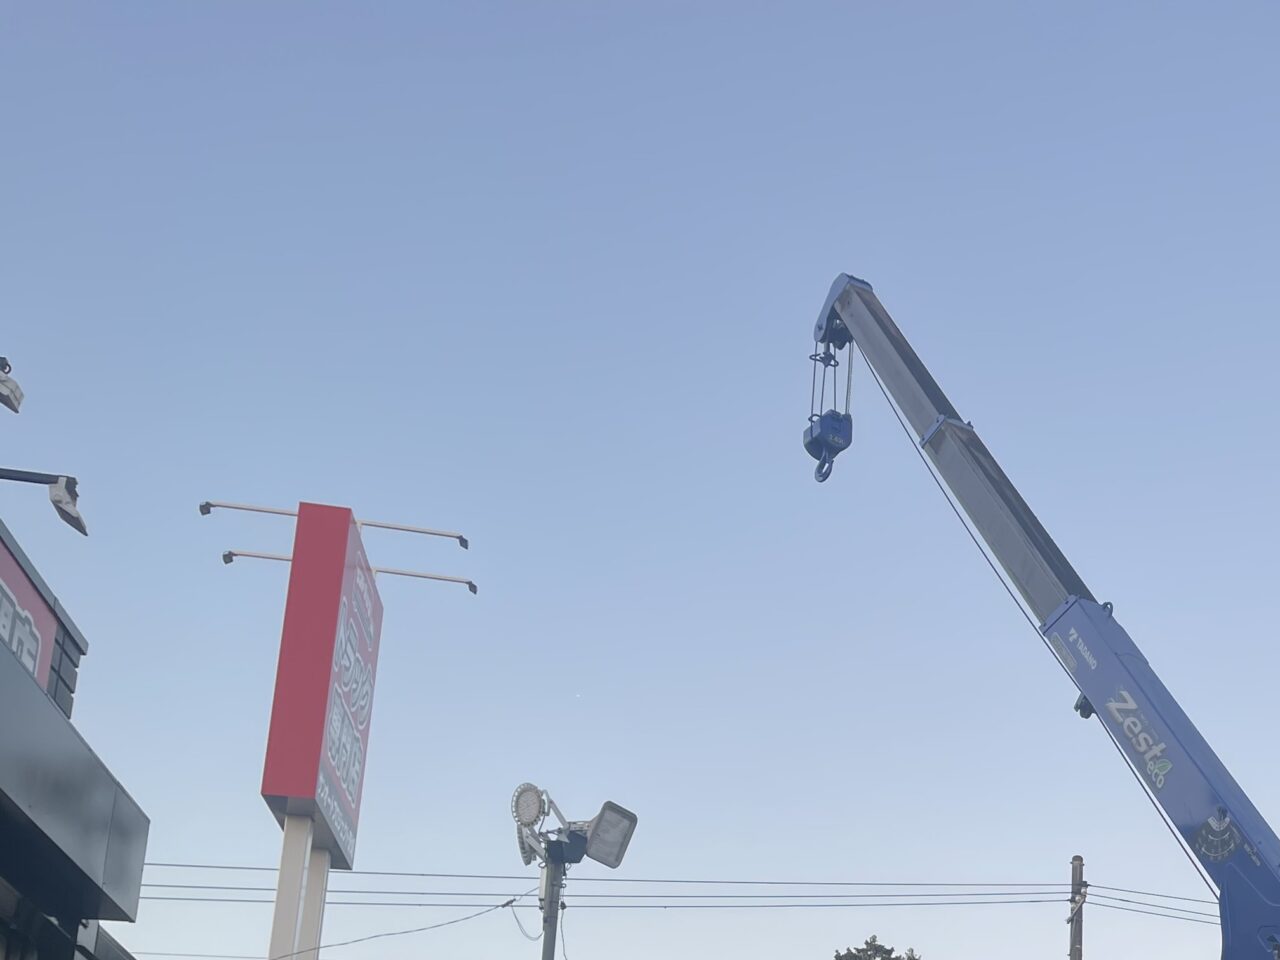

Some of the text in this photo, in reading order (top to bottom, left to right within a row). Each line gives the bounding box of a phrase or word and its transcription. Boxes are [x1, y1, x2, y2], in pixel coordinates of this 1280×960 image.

[1076, 637, 1098, 670] TADANO
[1105, 690, 1167, 762] Zest
[1146, 760, 1165, 789] eco
